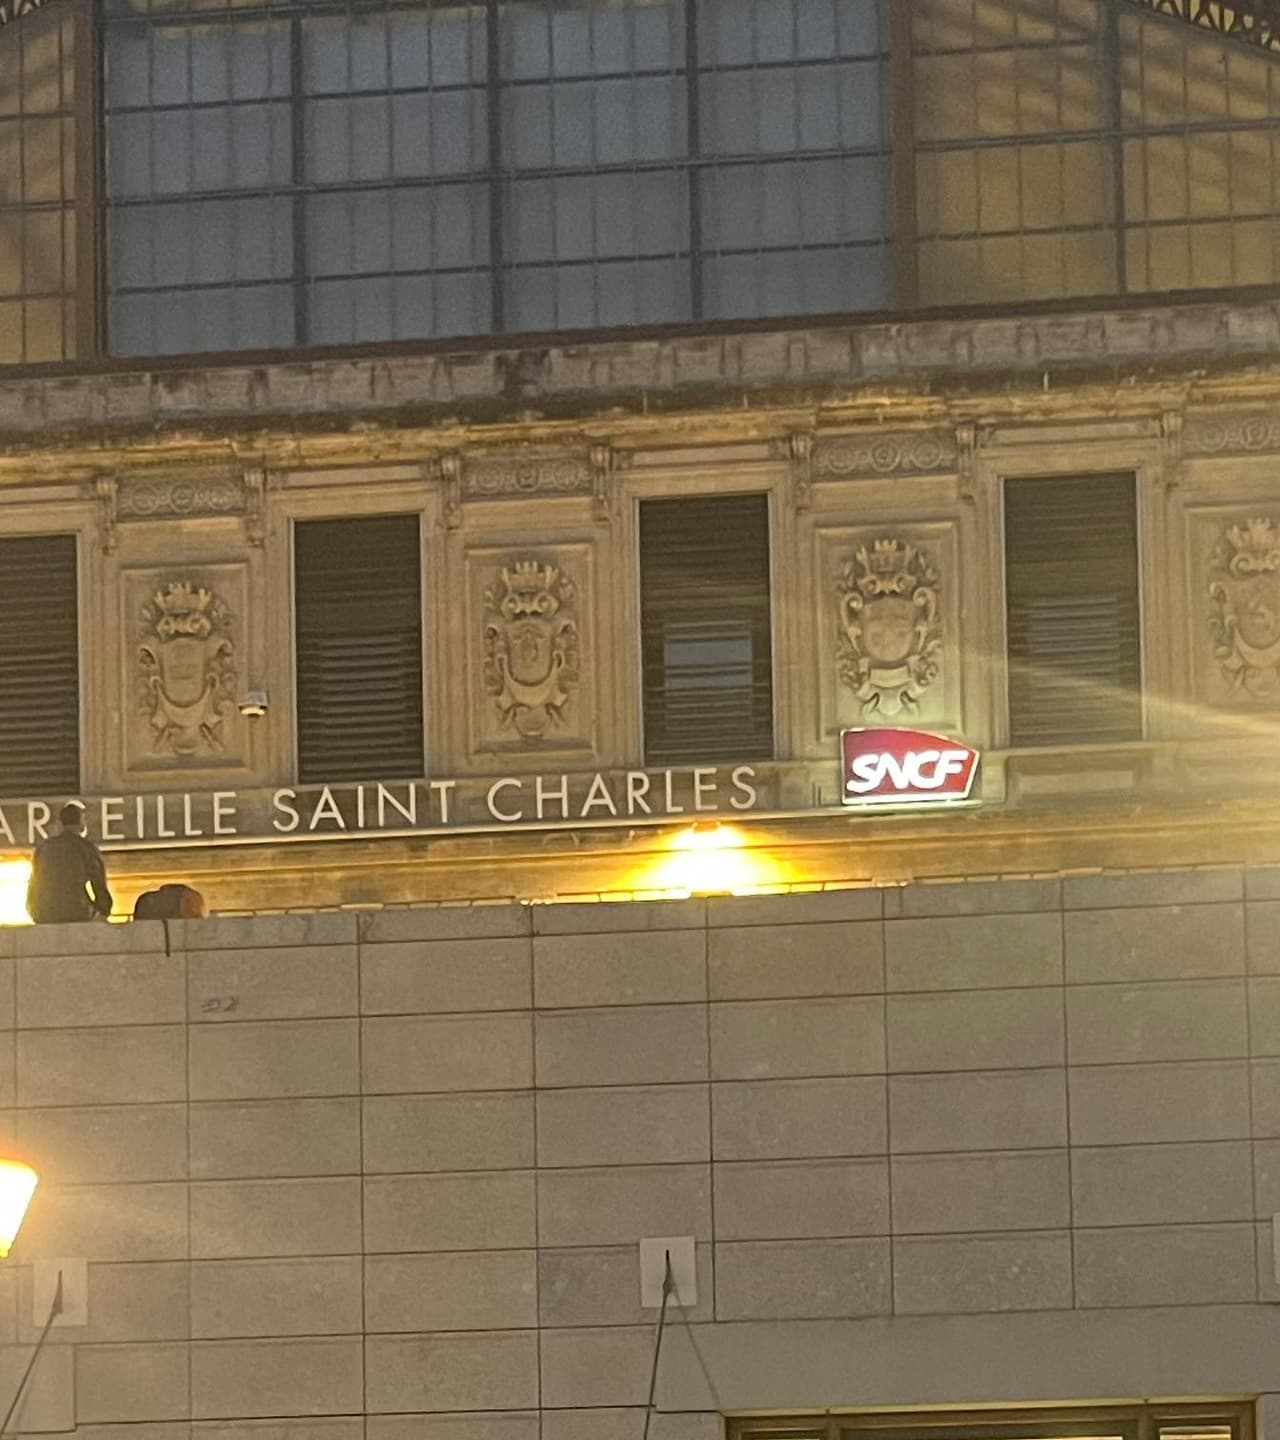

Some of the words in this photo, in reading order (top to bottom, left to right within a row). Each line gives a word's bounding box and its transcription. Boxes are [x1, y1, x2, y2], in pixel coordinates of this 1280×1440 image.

[272, 780, 456, 833] SAINT
[486, 765, 757, 823] CHARLES
[846, 749, 970, 794] SNCF
